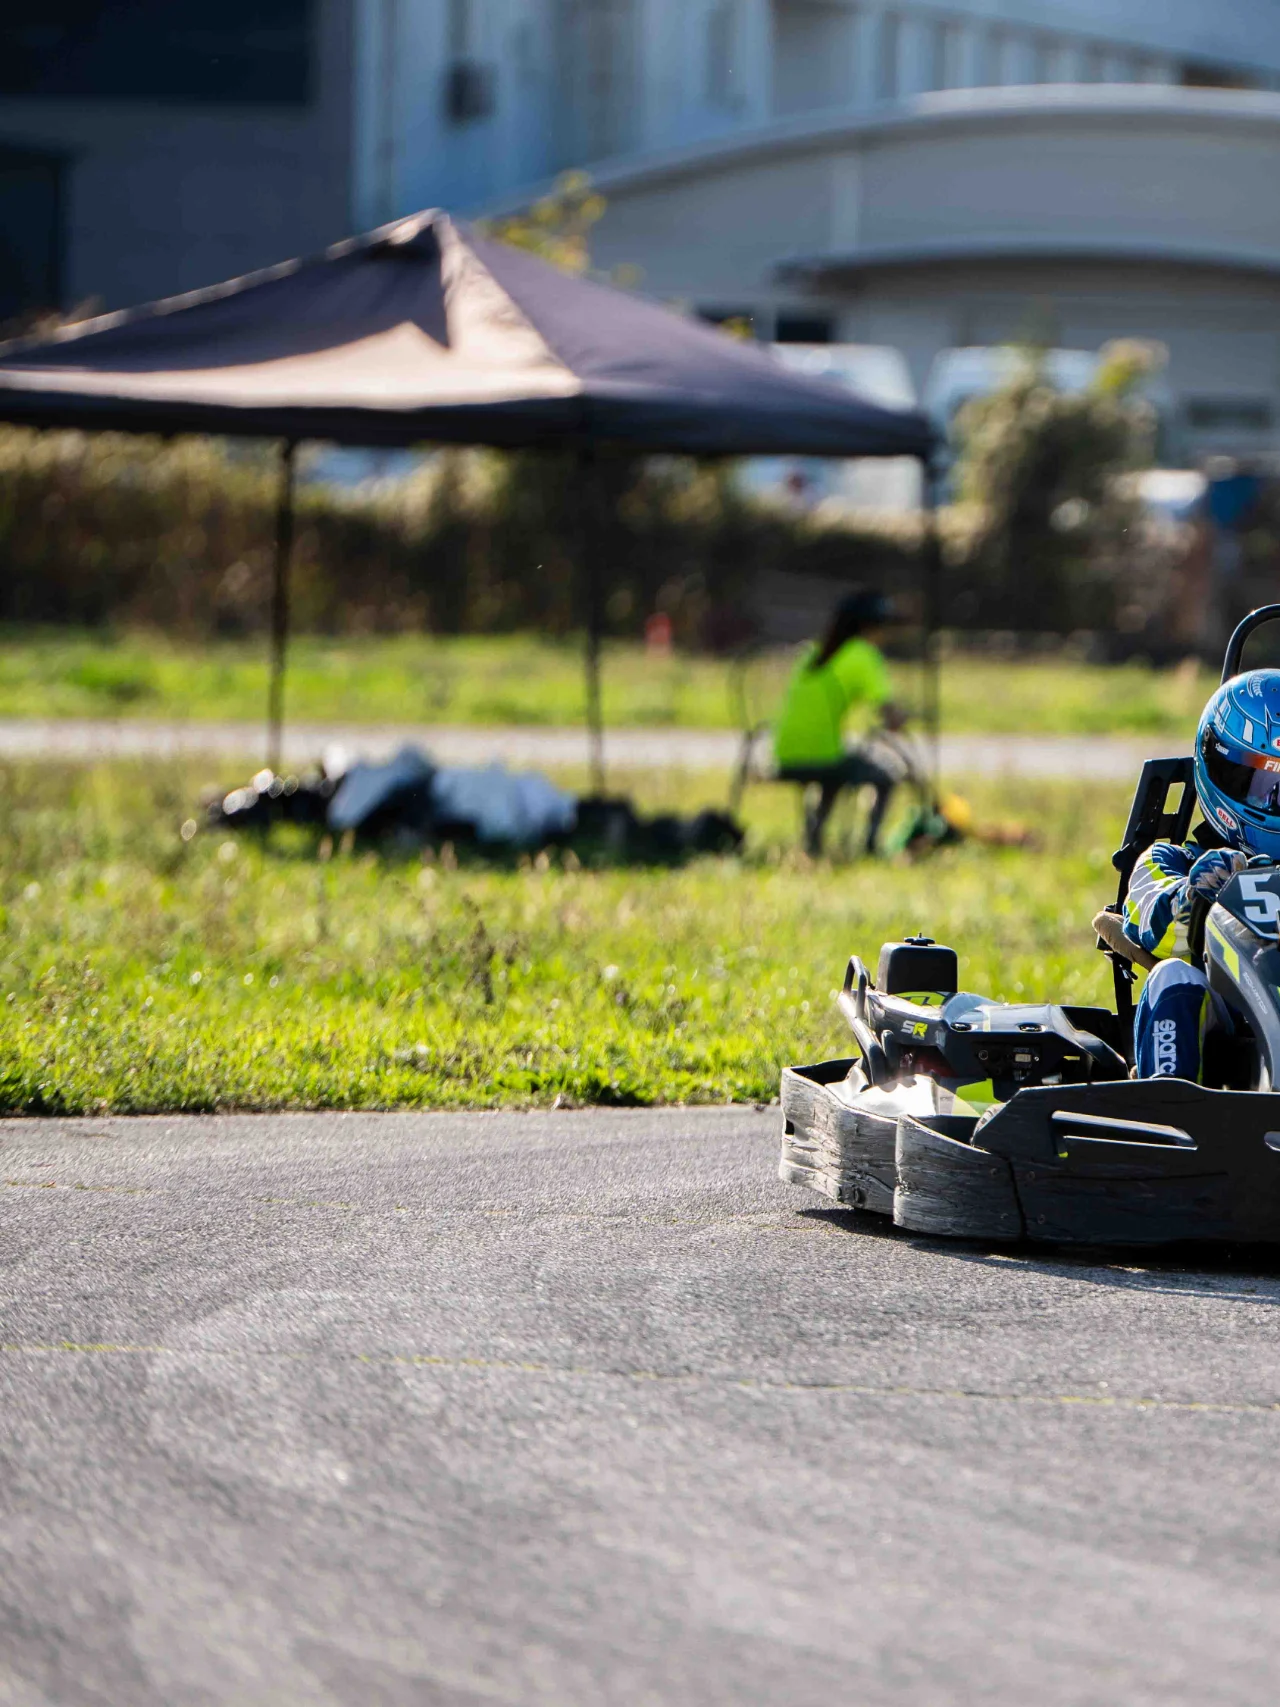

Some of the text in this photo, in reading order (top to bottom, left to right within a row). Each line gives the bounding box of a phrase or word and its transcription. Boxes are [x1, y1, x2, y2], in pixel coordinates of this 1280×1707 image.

[1217, 809, 1234, 828] BELL
[900, 1020, 929, 1037] SR
[1152, 1019, 1177, 1075] sparc
